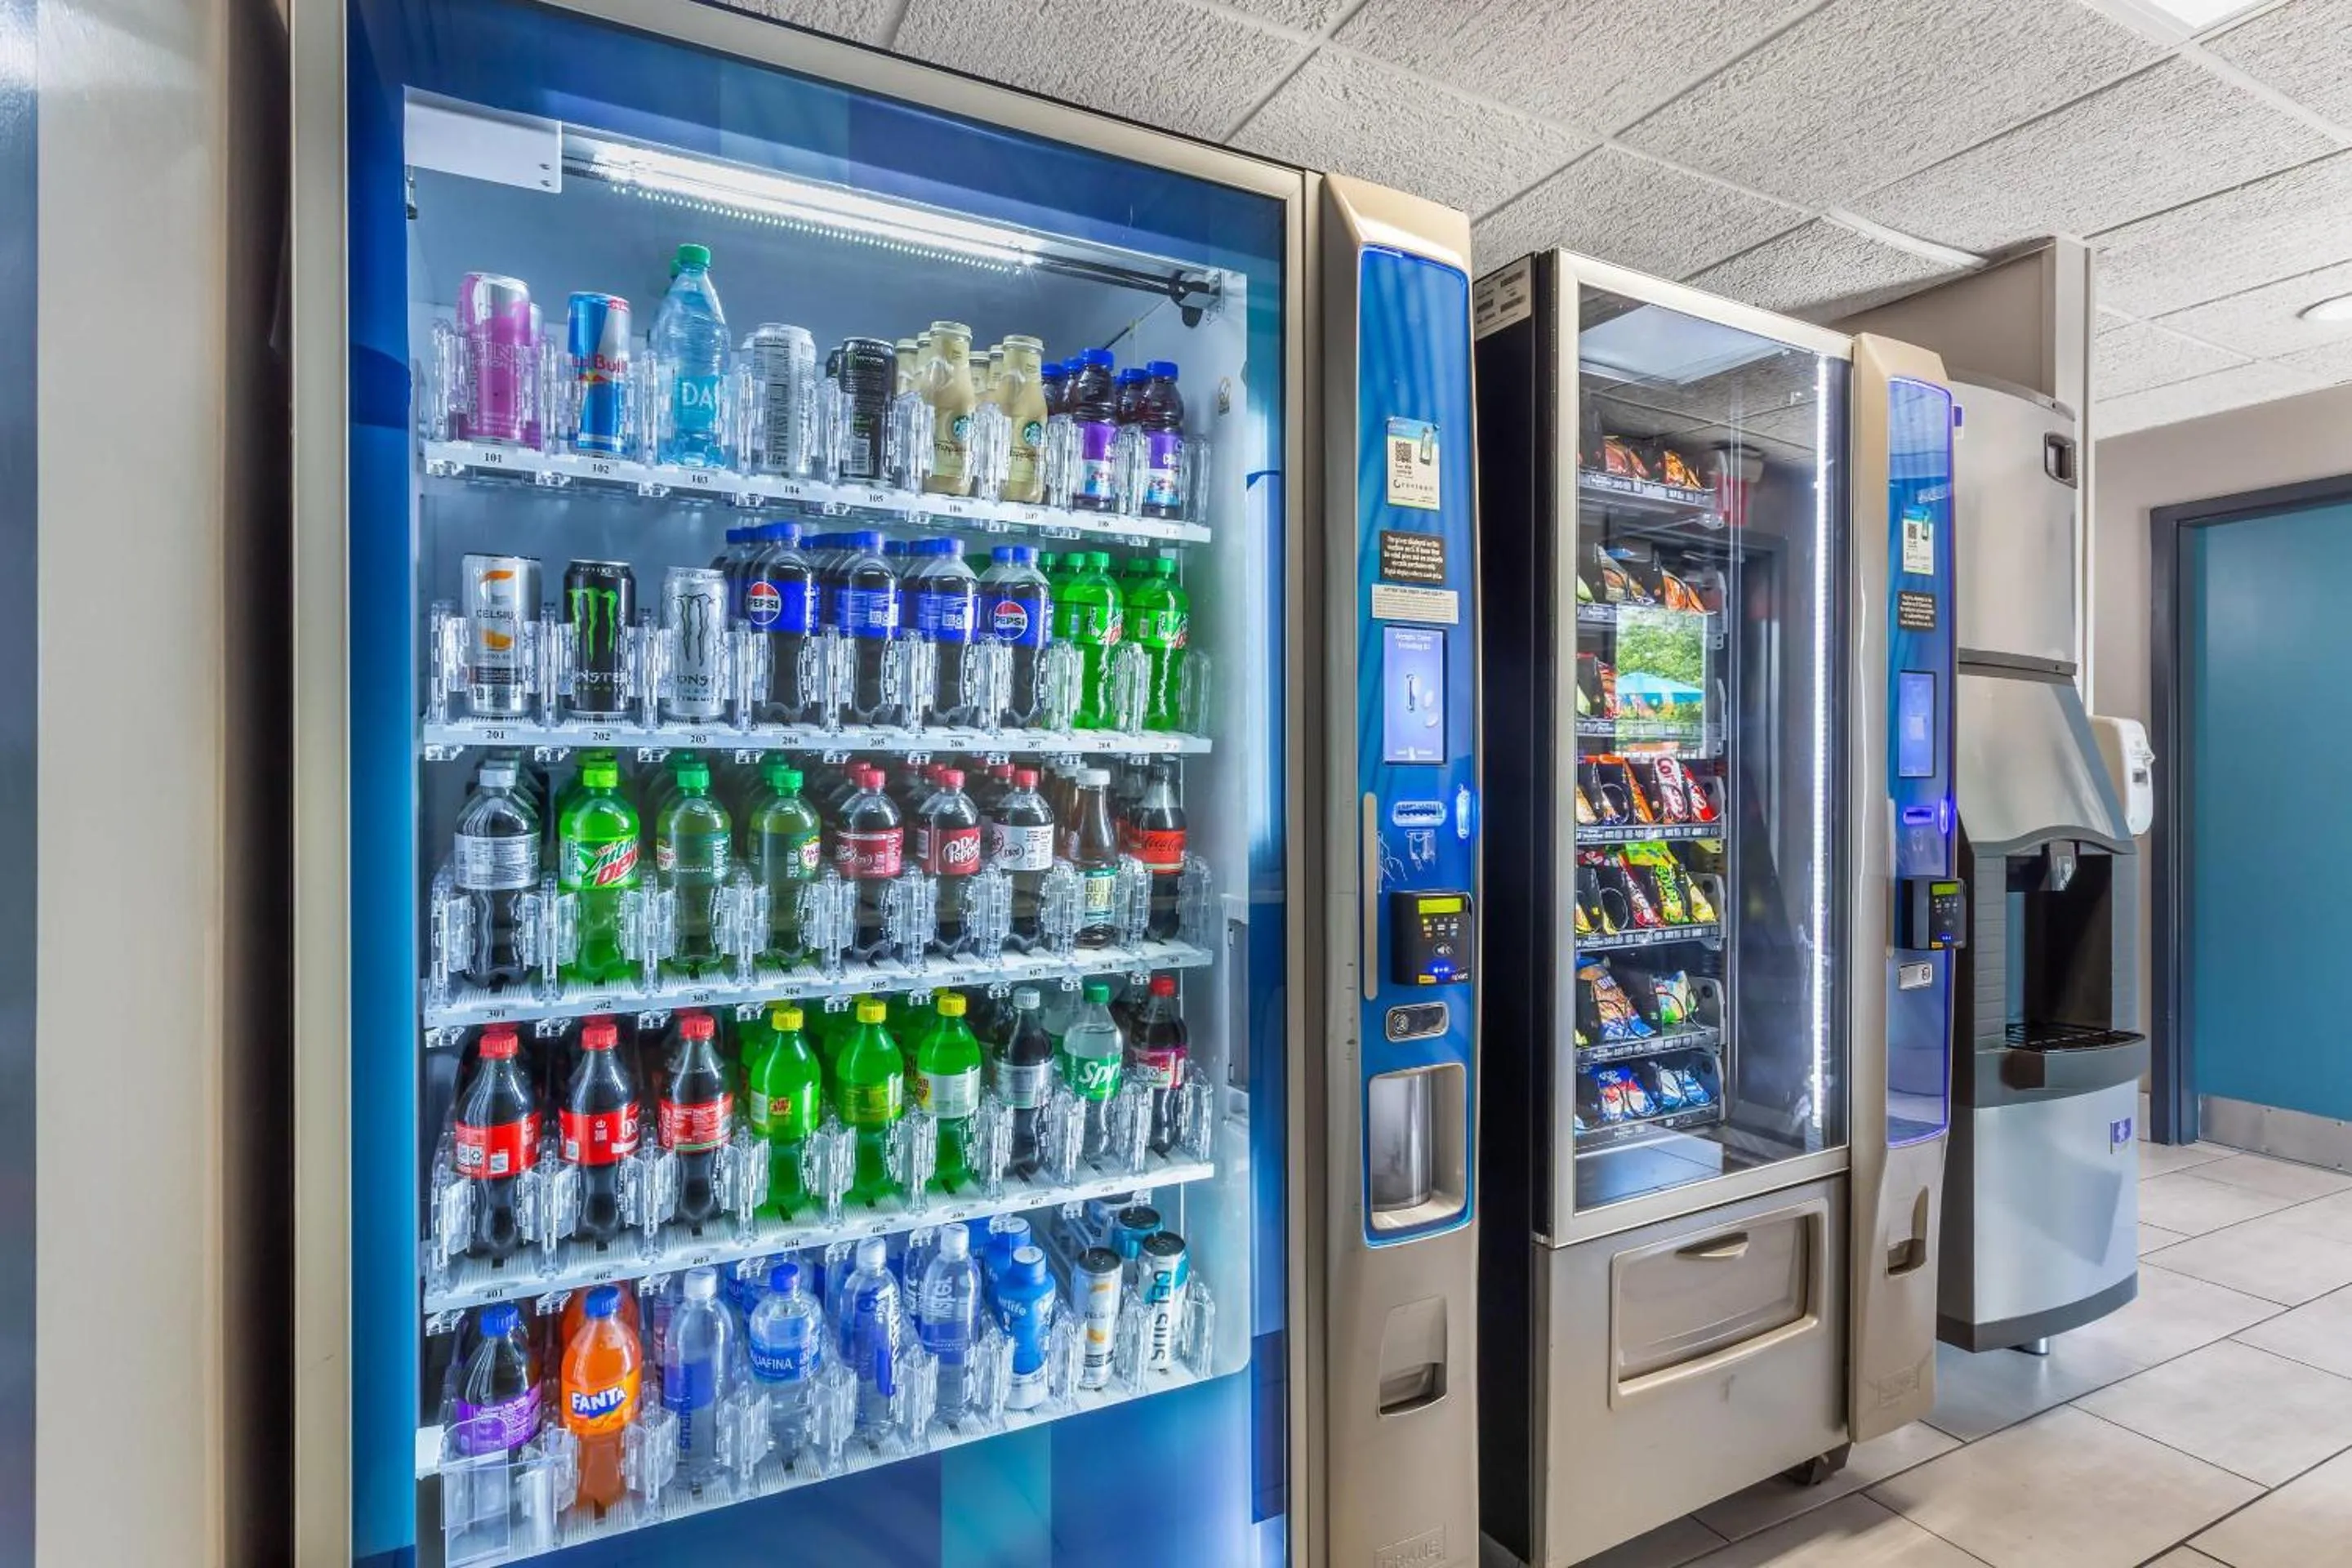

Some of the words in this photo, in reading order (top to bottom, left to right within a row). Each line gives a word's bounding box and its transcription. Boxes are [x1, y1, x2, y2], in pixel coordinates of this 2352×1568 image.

[484, 452, 502, 463] 101
[593, 464, 609, 474] 102
[692, 474, 708, 484] 103
[747, 597, 780, 610] PEPSI
[995, 616, 1027, 627] PEPSI
[487, 731, 505, 740] 201
[593, 733, 610, 742] 202
[691, 735, 707, 744] 203
[593, 1000, 611, 1010] 302
[487, 1009, 506, 1018] 301
[595, 1271, 612, 1281] 402
[487, 1290, 503, 1298] 401
[1151, 1271, 1171, 1361] CELSIUS
[571, 1387, 627, 1412] FANTA
